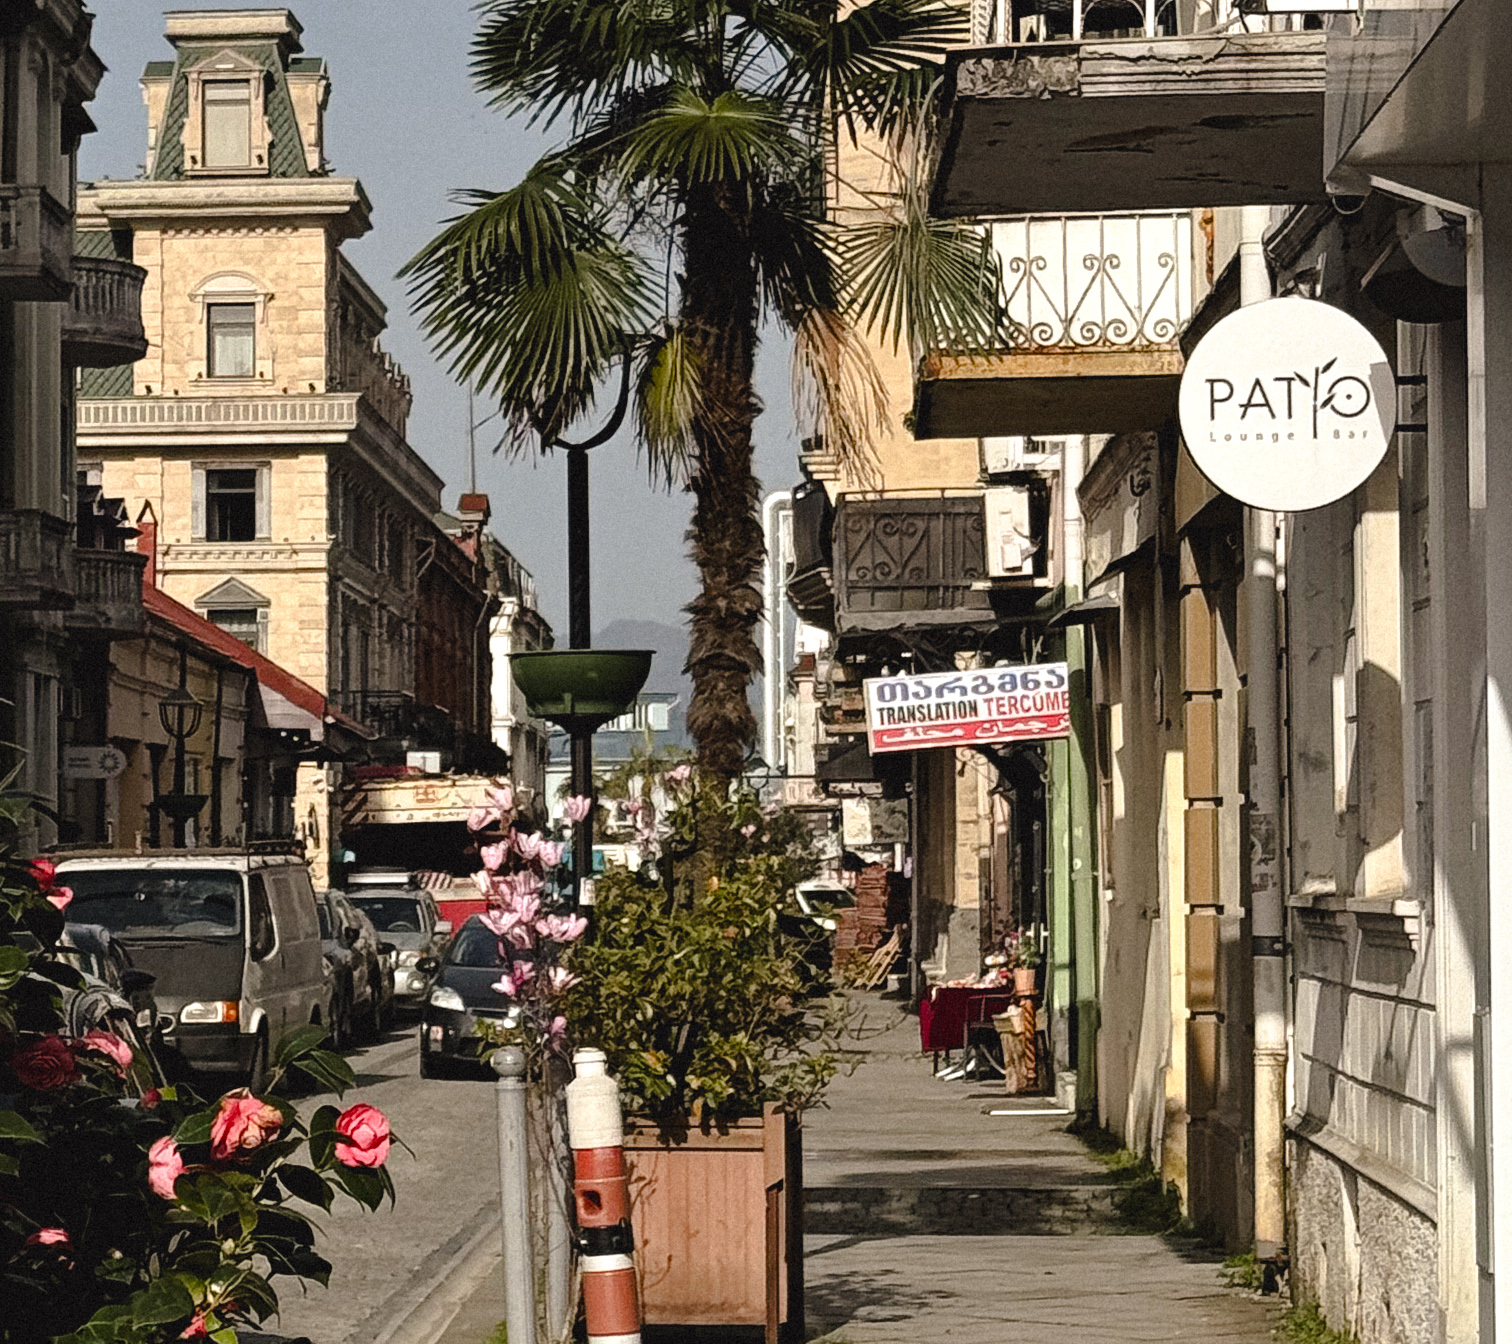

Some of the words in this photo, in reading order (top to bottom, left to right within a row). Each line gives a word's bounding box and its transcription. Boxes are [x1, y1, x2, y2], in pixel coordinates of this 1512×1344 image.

[1209, 431, 1295, 443] Lounge
[1333, 428, 1368, 440] Bar
[876, 669, 1066, 703] თარგმნა
[876, 699, 979, 726] TRANSLATION
